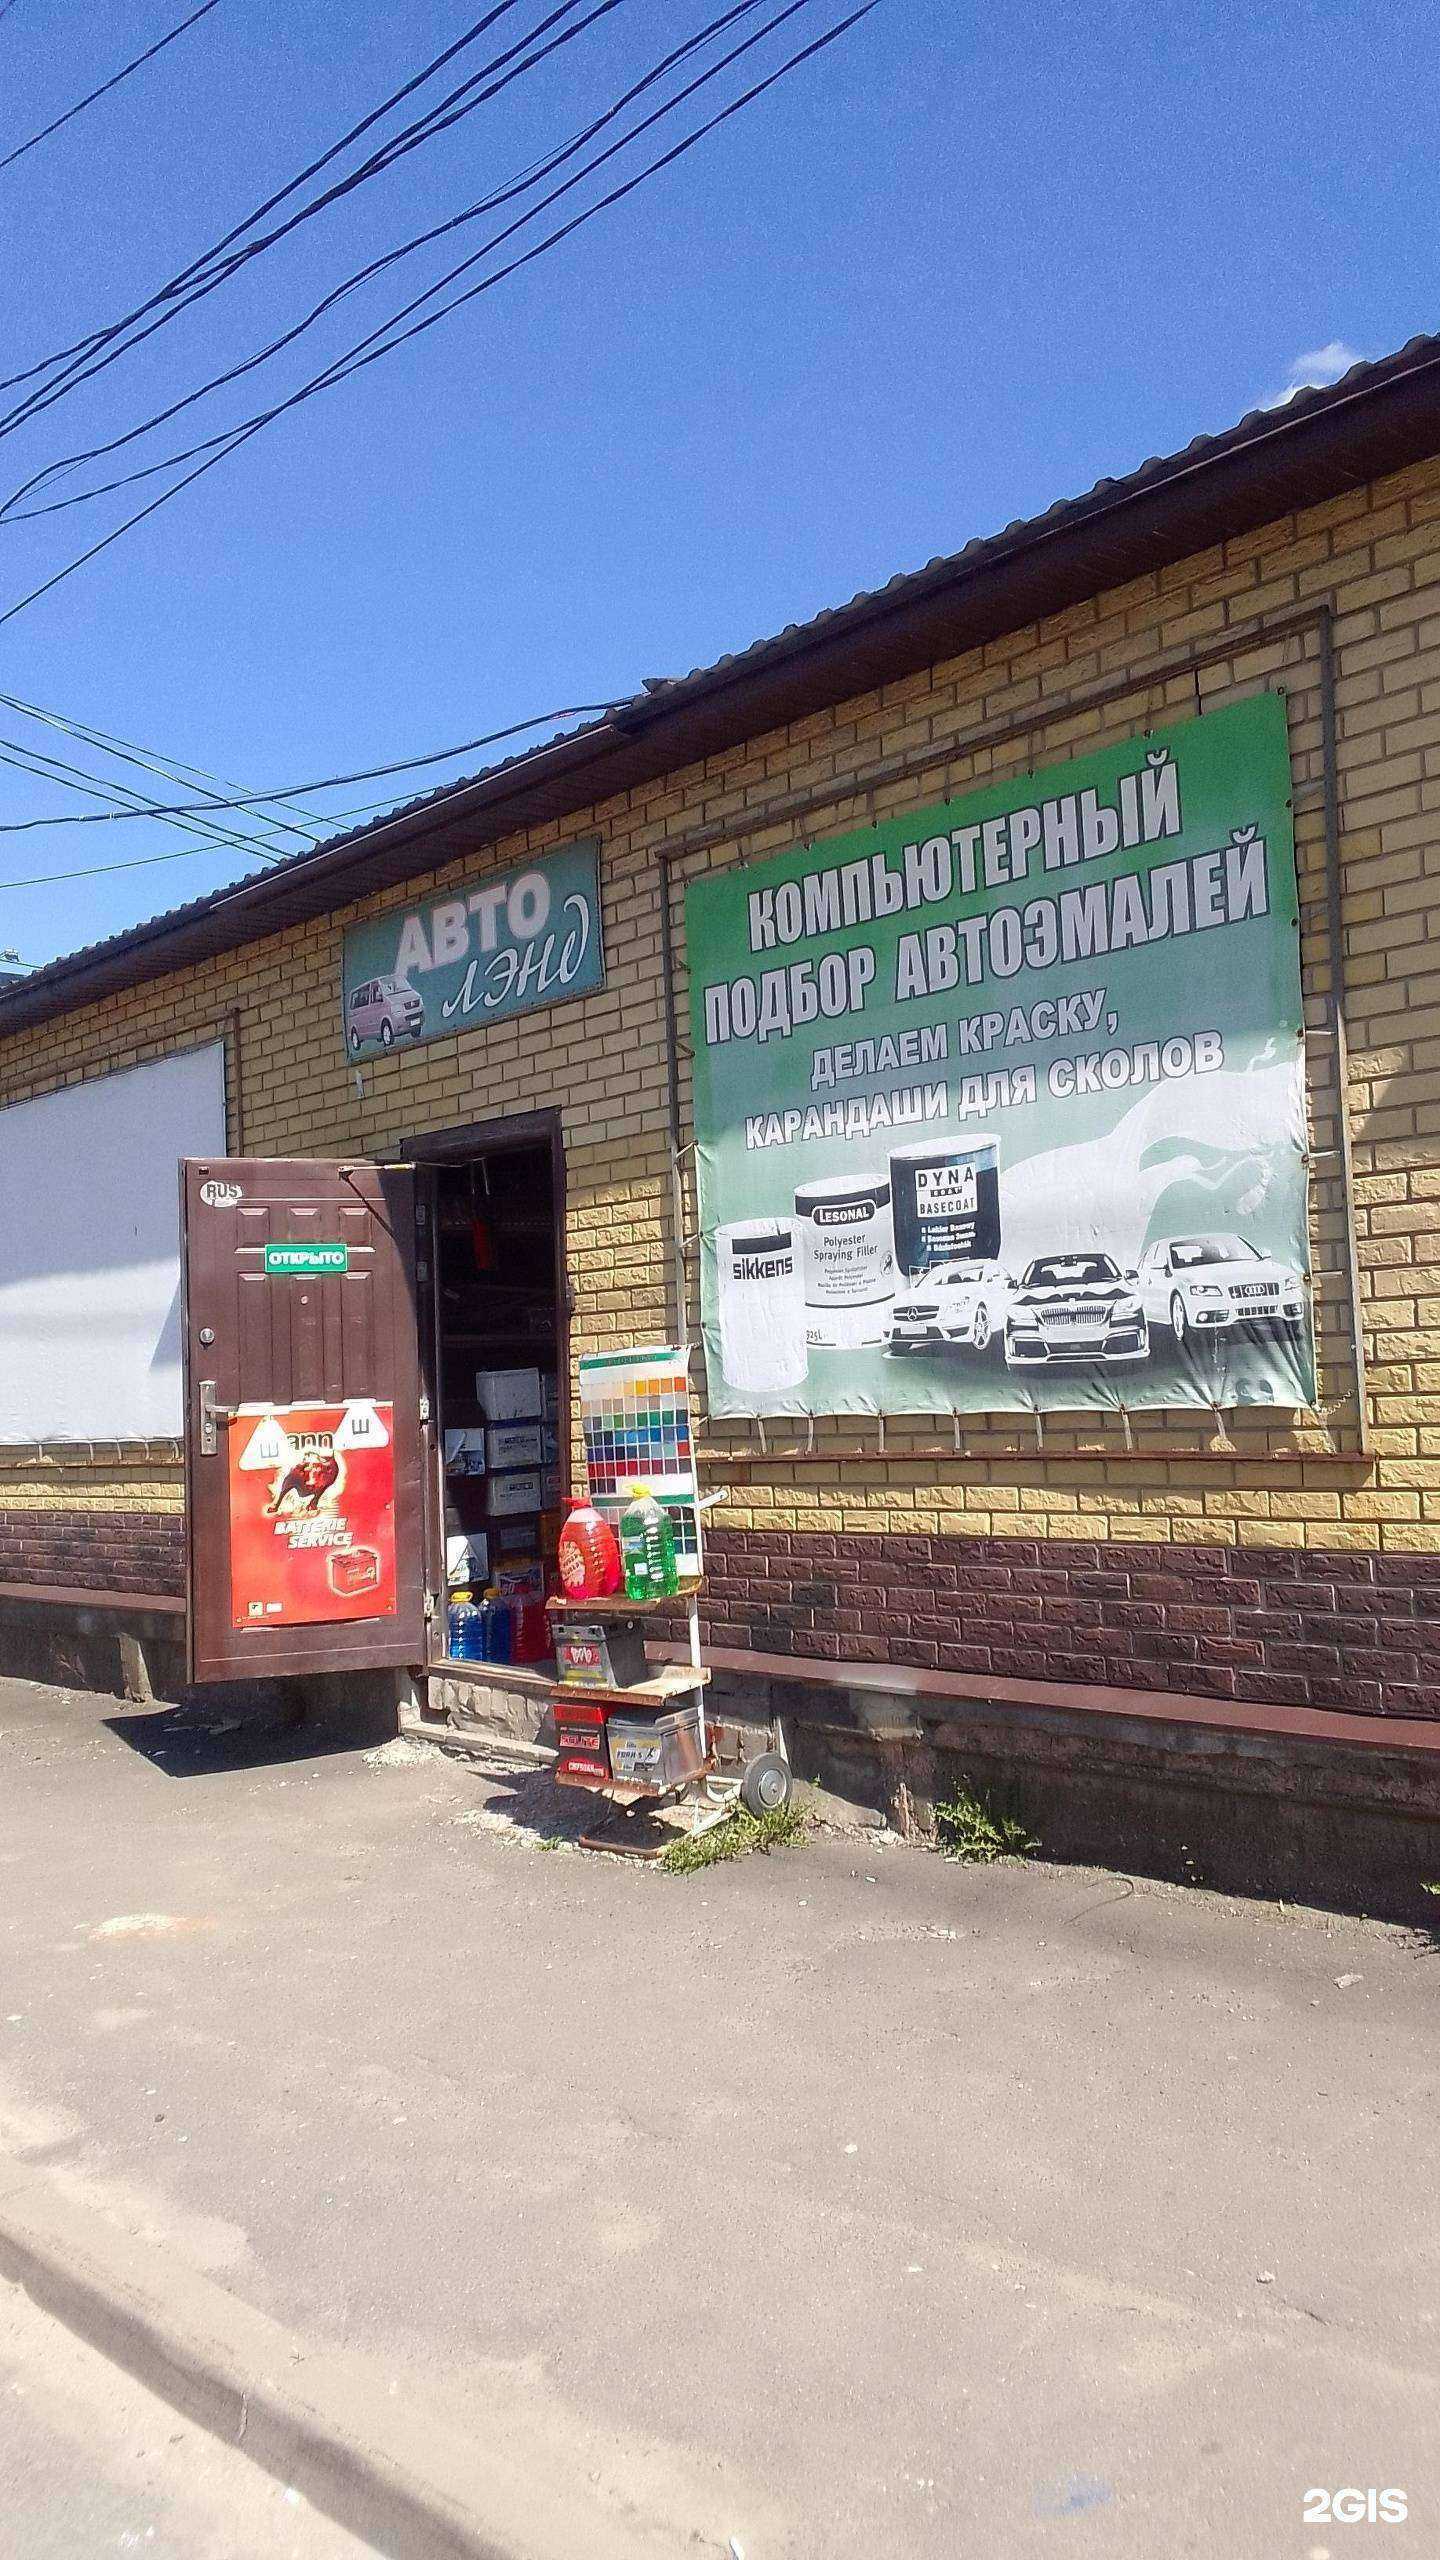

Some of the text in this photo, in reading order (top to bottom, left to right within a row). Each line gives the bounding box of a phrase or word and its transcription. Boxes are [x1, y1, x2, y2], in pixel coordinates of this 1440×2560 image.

[748, 749, 1182, 953] КОМПЬЮТЕРНЫЙ
[394, 870, 550, 978] АВТО
[704, 825, 1270, 1045] ПОДБОР АВТОЭМАЛЕЙ
[811, 987, 1119, 1091] ДЕЛАЕМ КРАСКУ,
[745, 1030, 1225, 1151] КАРАНДАШИ ДЛЯ СКОЛОВ
[918, 1166, 974, 1188] DYNA
[206, 1183, 239, 1199] RUS
[819, 1206, 871, 1223] LESONAL
[920, 1197, 975, 1214] BASECOAT
[823, 1234, 866, 1248] Polyester
[268, 1251, 345, 1266] ОТКРЫТО
[813, 1244, 879, 1263] Spraying Filler
[732, 1256, 793, 1279] sikkens
[351, 1418, 370, 1435] Ш
[287, 1532, 354, 1549] SERVICE
